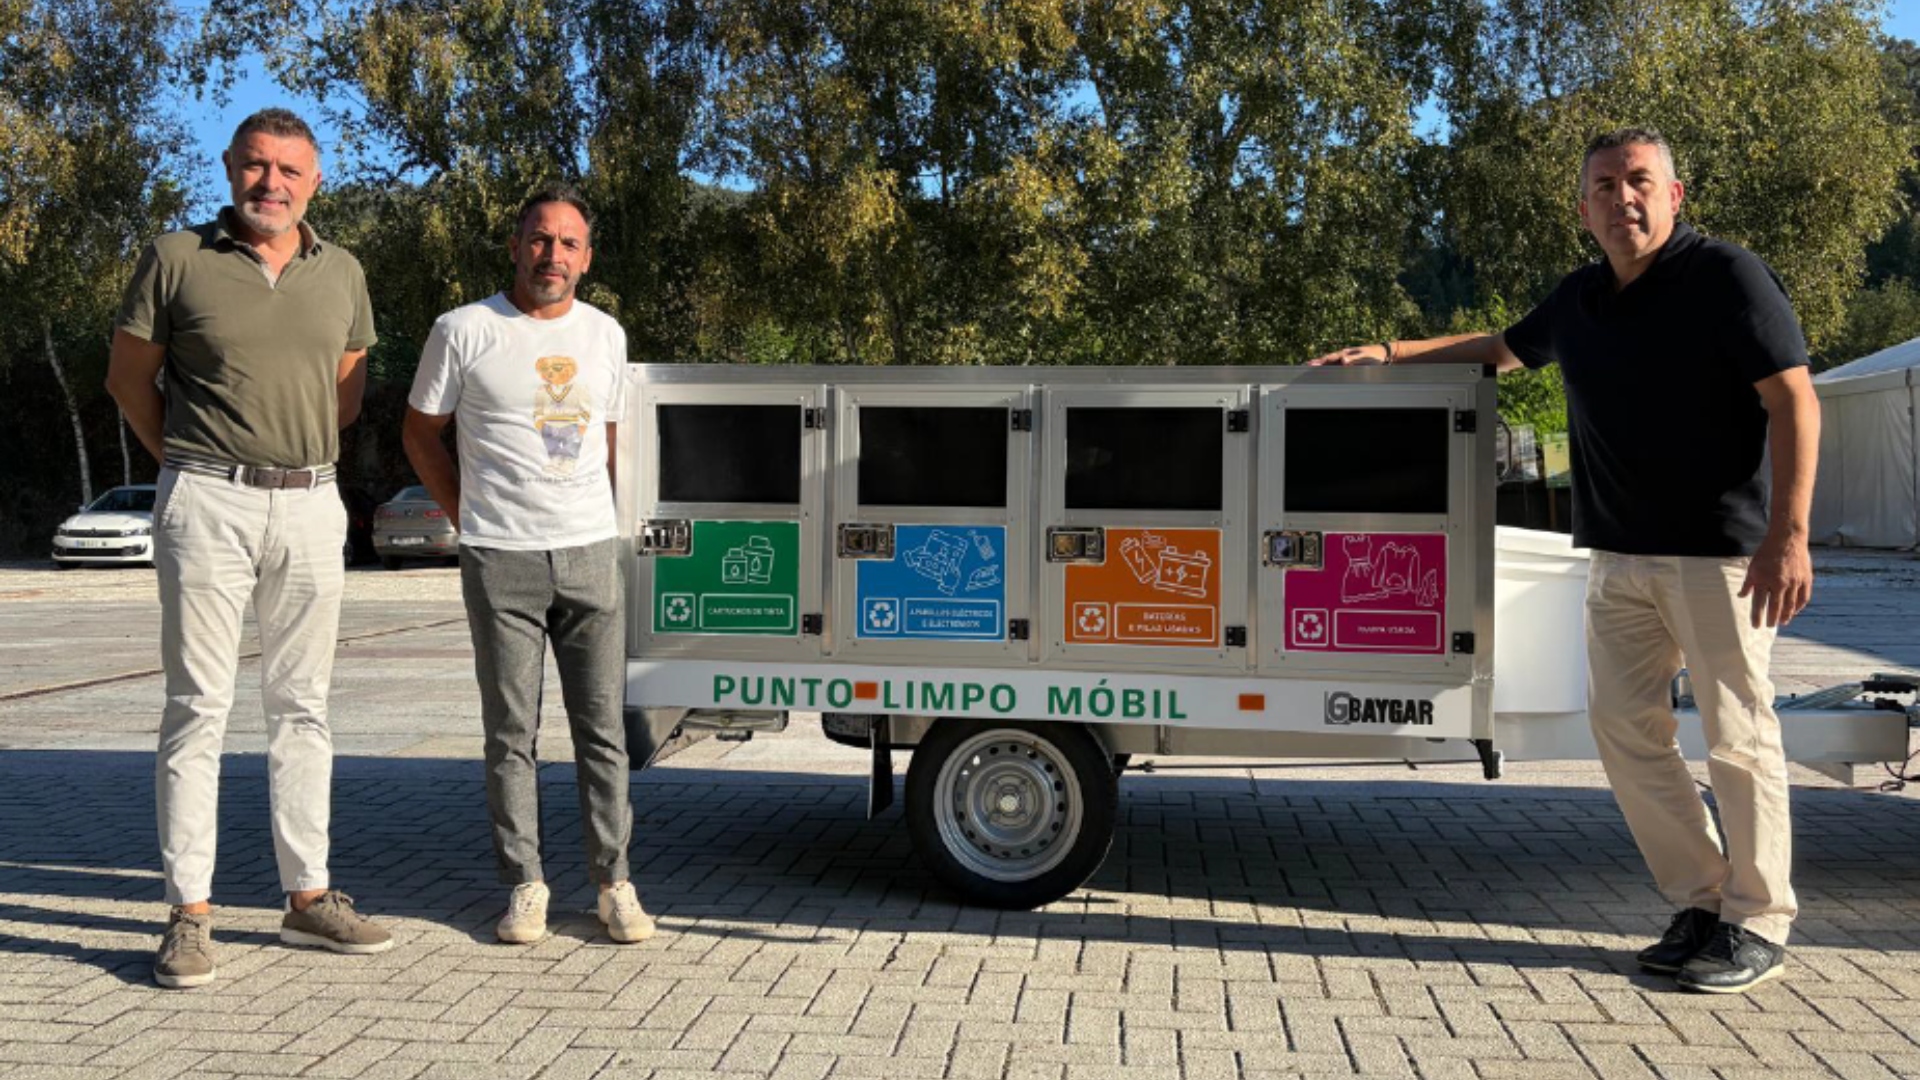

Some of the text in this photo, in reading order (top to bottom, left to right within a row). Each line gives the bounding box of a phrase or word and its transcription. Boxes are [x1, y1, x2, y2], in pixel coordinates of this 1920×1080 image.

[713, 674, 1187, 719] PUNTO LIMPO MÓBIL
